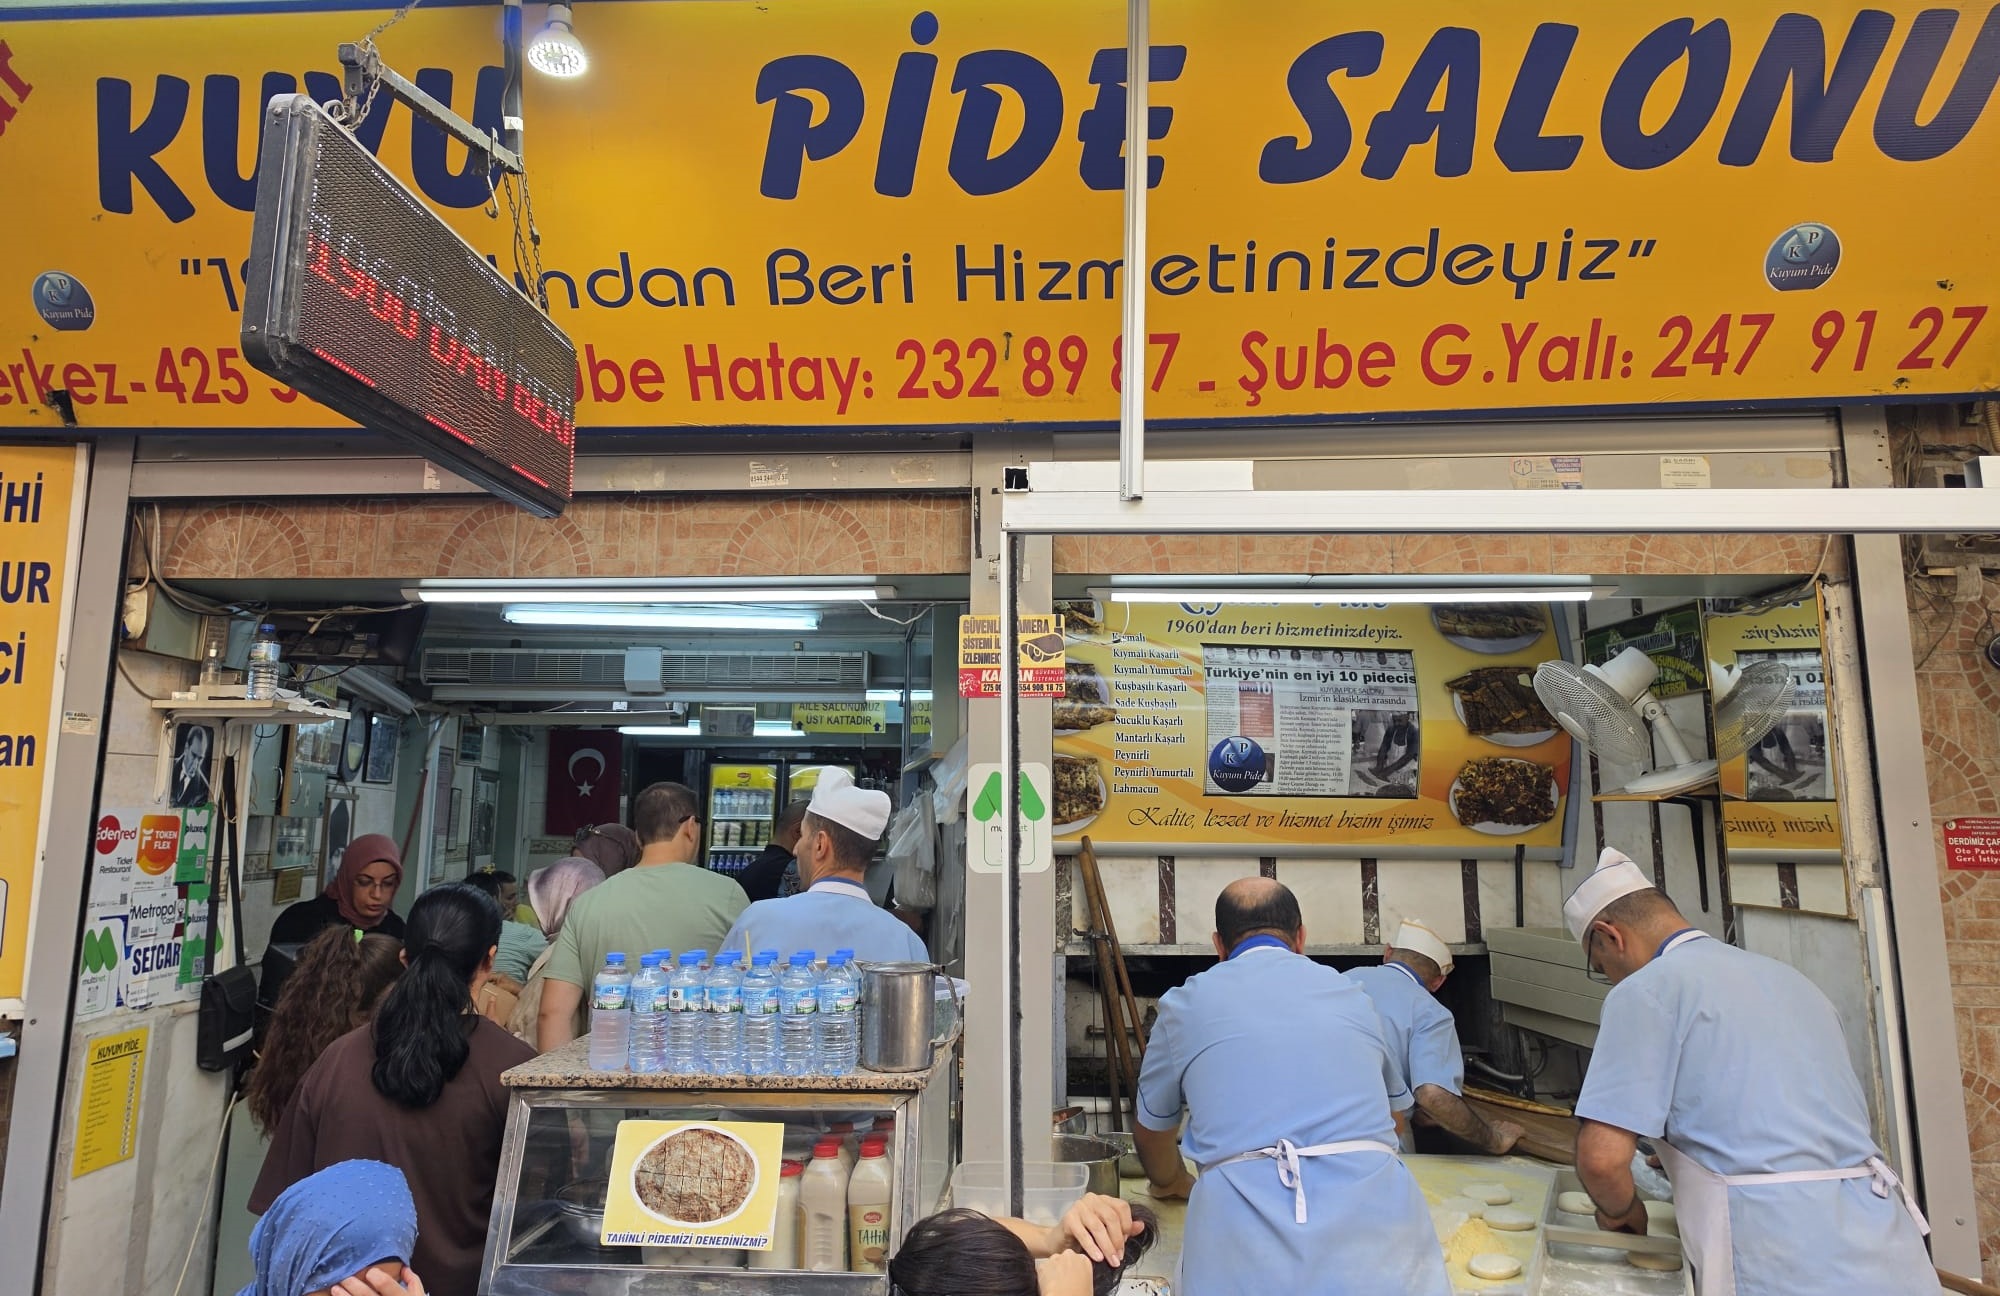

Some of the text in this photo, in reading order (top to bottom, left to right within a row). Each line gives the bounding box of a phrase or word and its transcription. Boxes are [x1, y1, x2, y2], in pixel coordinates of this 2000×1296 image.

[755, 11, 1187, 200] PİDE
[1259, 8, 2000, 184] SALONU
[766, 248, 914, 306] Beri
[1770, 267, 1807, 281] Kuyum
[42, 308, 73, 321] Kuyum
[684, 342, 872, 416] Hatay:
[895, 337, 999, 400] 232
[1021, 333, 1088, 397] 89
[1238, 327, 1396, 405] Şube
[1652, 313, 1774, 378] 247
[1810, 309, 1877, 374] 91
[1896, 305, 1989, 370] 27
[1167, 618, 1403, 643] 1960'dan beri hizmetinizdeyiz.
[1112, 648, 1180, 661] Kıymalı Kaşarlı
[1113, 665, 1193, 677] Kıymalı Yumurtalı
[1293, 671, 1312, 681] en
[1316, 670, 1335, 682] iyi
[1339, 671, 1358, 682] 10
[1156, 683, 1188, 694] Kaşarlı
[1115, 698, 1136, 708] Sade
[1115, 715, 1184, 727] Sucuklu Kaşarlı
[1115, 732, 1186, 745] Mantarlı Kaşarlı
[1115, 749, 1150, 761] Peynirli
[1114, 767, 1195, 779] Peynirli Yumurtalı
[1113, 784, 1159, 795] Lahmacun
[1278, 808, 1333, 829] hizmet
[1336, 809, 1382, 830] bizim
[606, 1232, 646, 1244] TAHİNLİ
[647, 1232, 693, 1245] PİDEMİZİ
